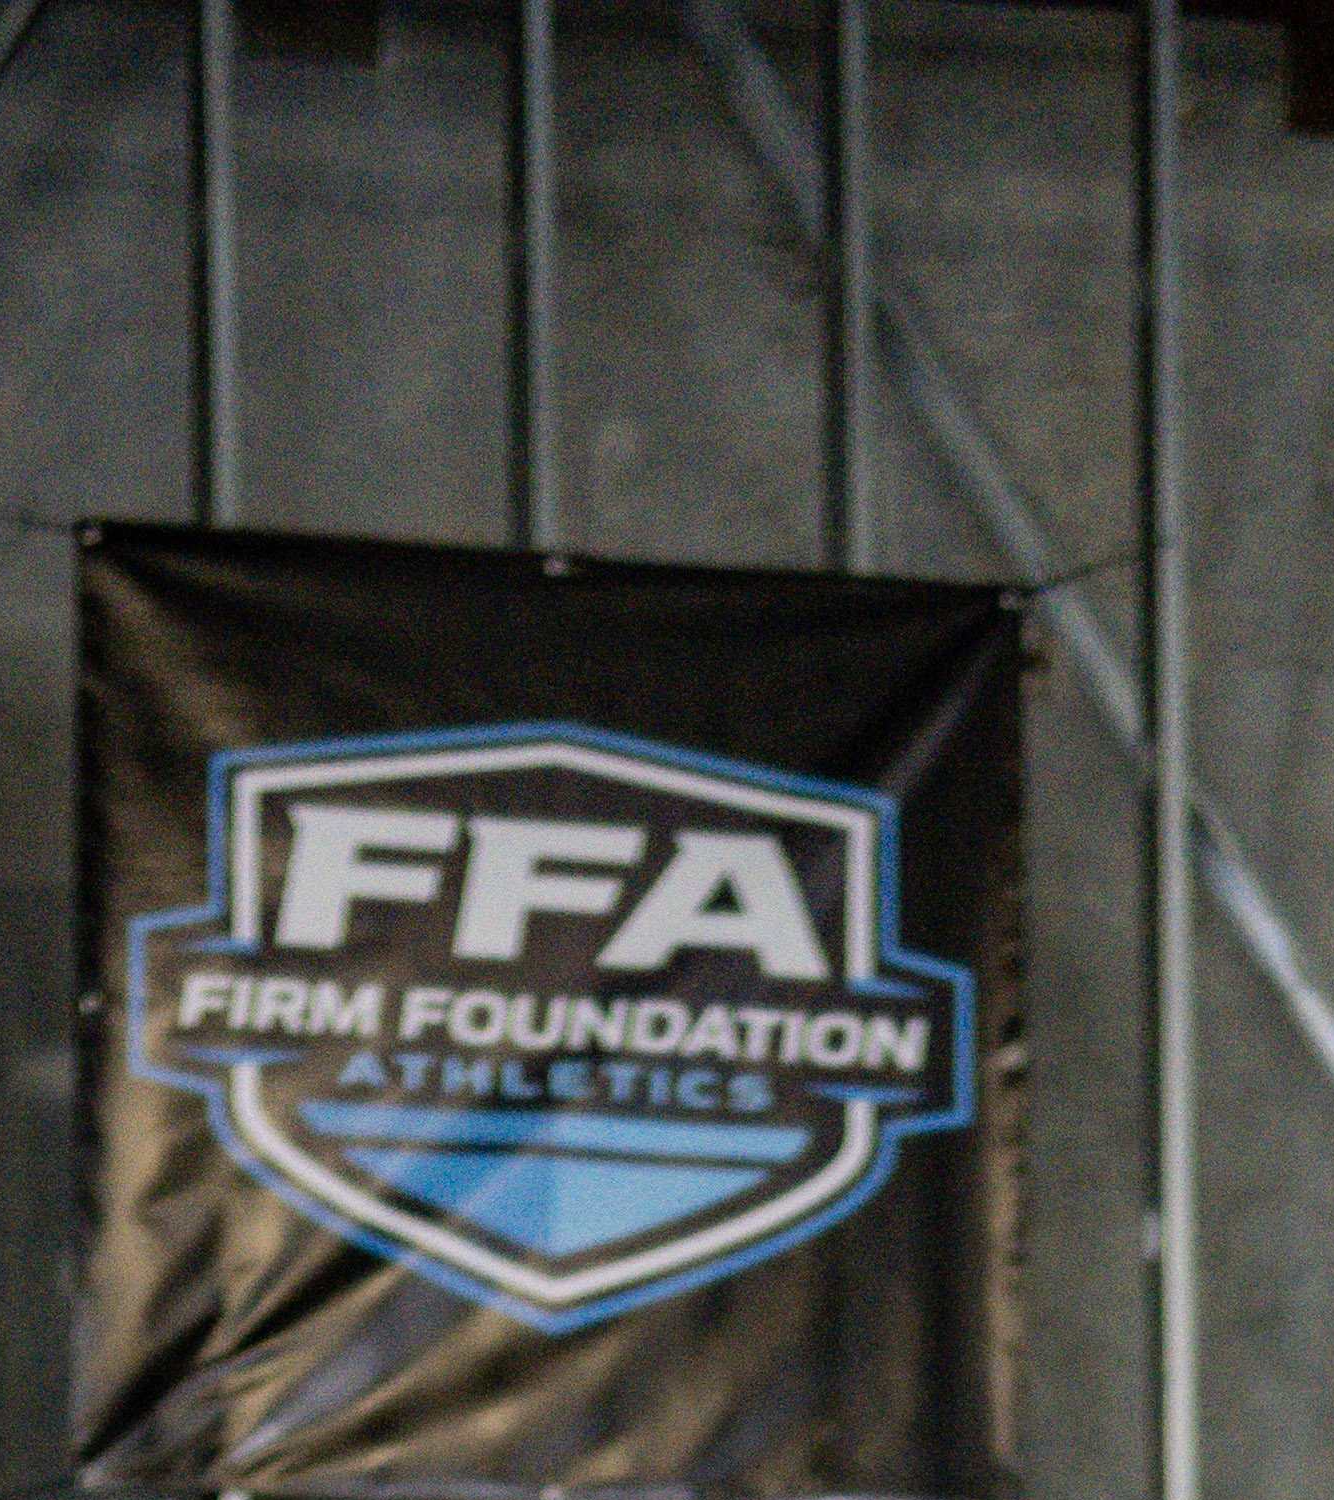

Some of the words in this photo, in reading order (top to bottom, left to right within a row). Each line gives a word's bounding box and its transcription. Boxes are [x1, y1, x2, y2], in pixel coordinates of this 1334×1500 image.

[275, 803, 831, 982] FFA
[176, 972, 383, 1036] FIRM
[399, 988, 931, 1071] FOUNDATION
[338, 1052, 774, 1113] ATHLETICS
